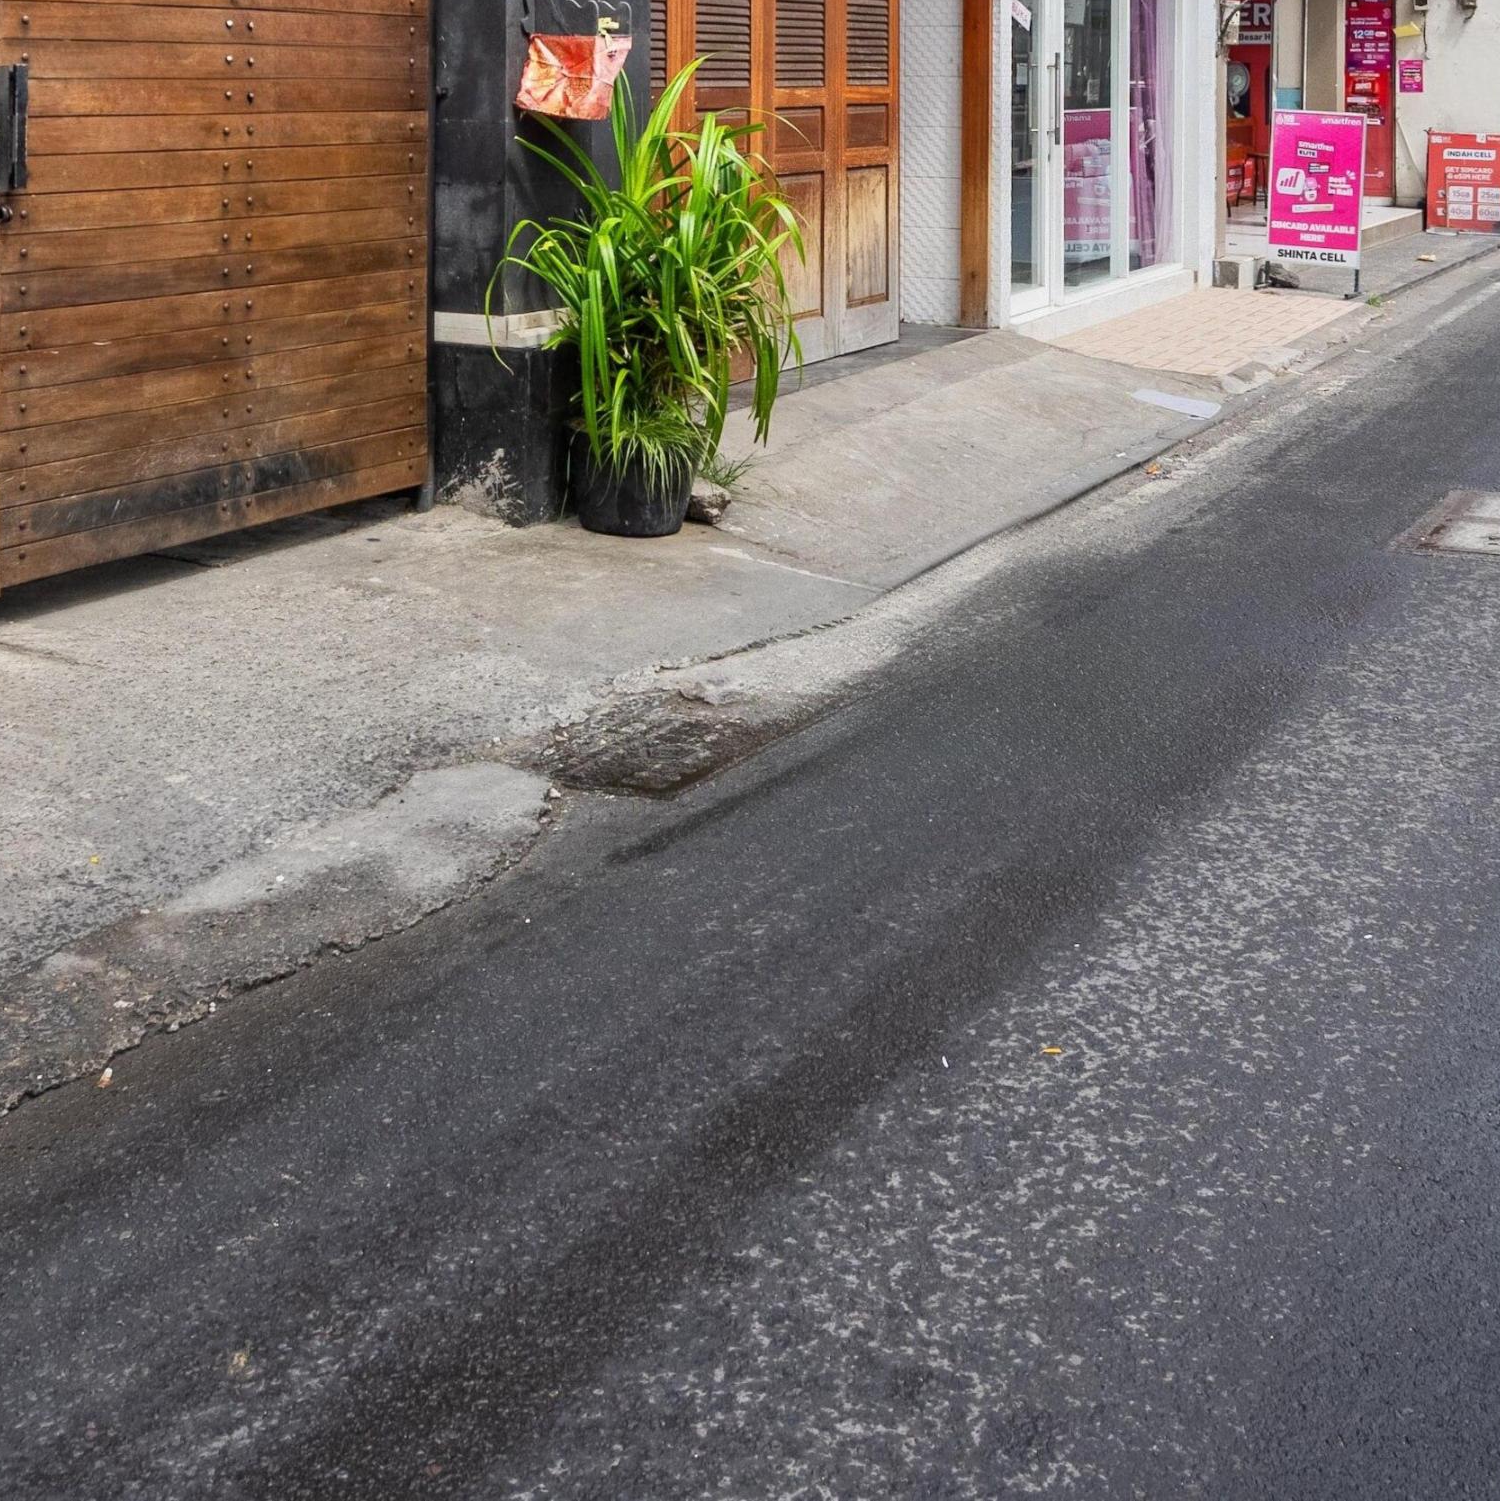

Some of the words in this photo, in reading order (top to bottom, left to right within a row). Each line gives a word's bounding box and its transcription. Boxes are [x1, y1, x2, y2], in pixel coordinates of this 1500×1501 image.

[1321, 117, 1362, 127] smartfren
[1271, 220, 1310, 232] SIMCARD
[1309, 223, 1356, 235] AVAILABLE
[1277, 249, 1318, 261] SHINTA
[1320, 251, 1346, 263] CELL
